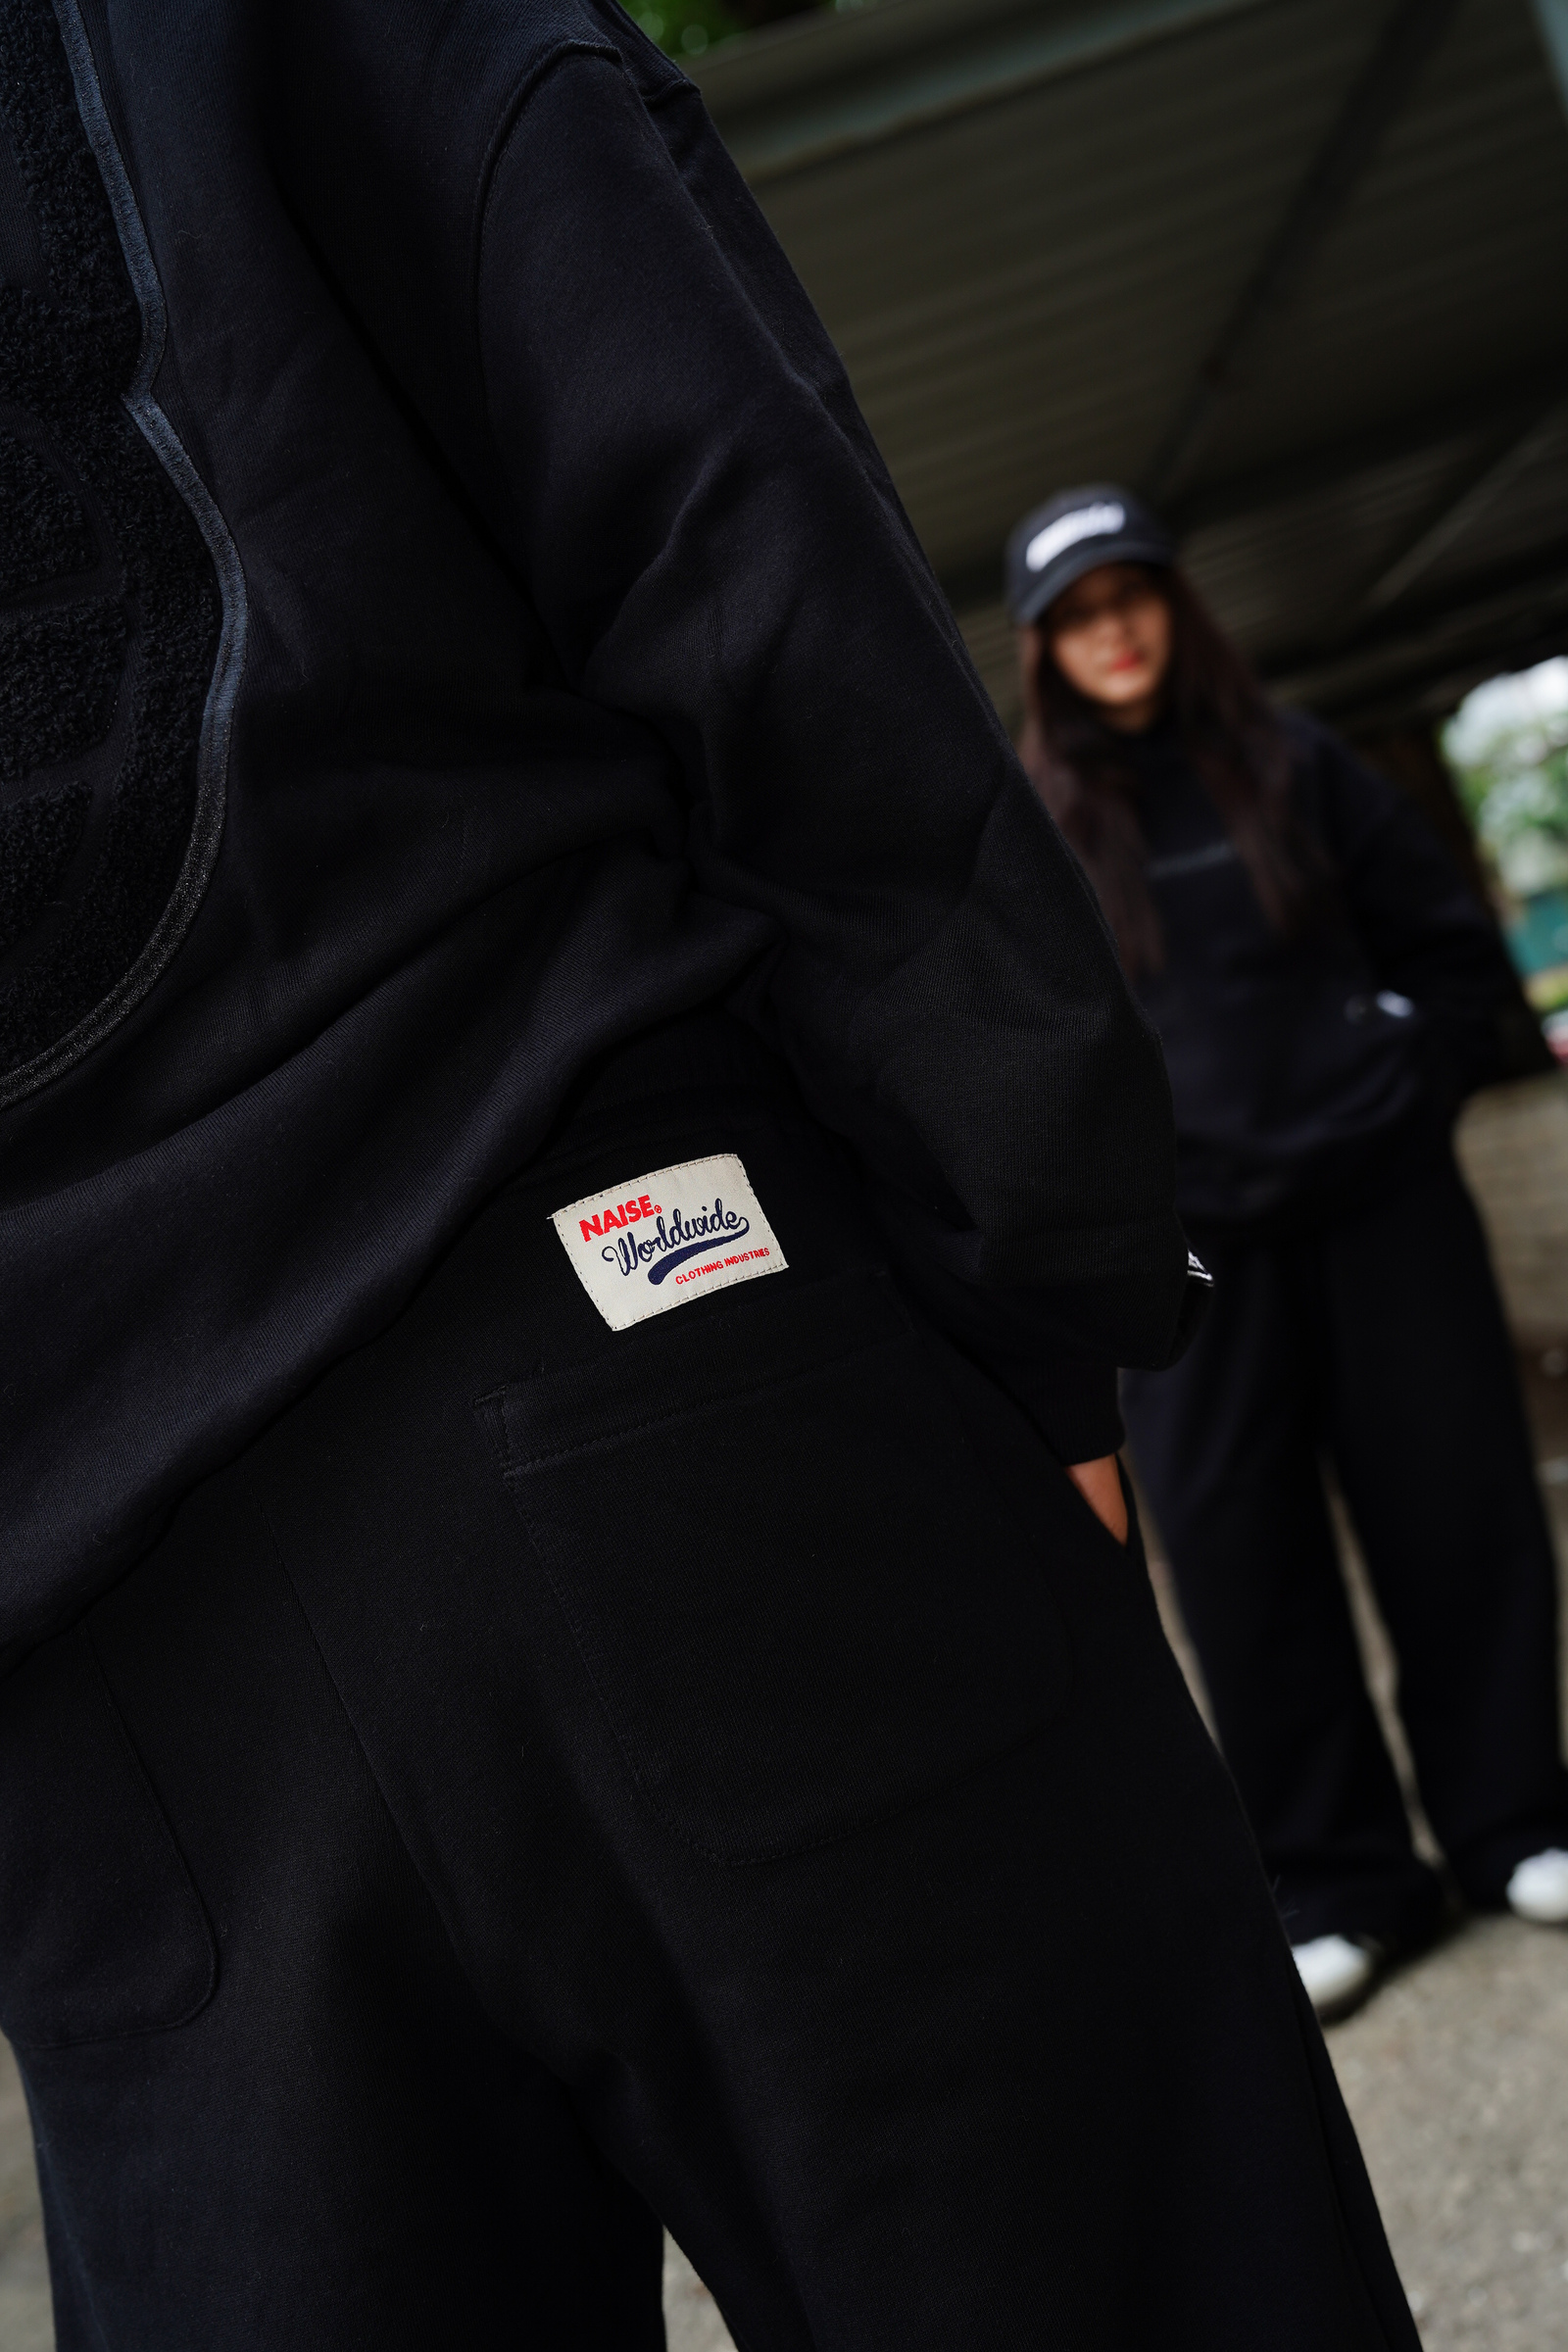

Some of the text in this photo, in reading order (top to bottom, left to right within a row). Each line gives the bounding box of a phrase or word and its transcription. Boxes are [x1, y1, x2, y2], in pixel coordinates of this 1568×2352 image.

[602, 1198, 749, 1277] Worldwide
[675, 1248, 770, 1286] CLOTHING INDUSTRIES
